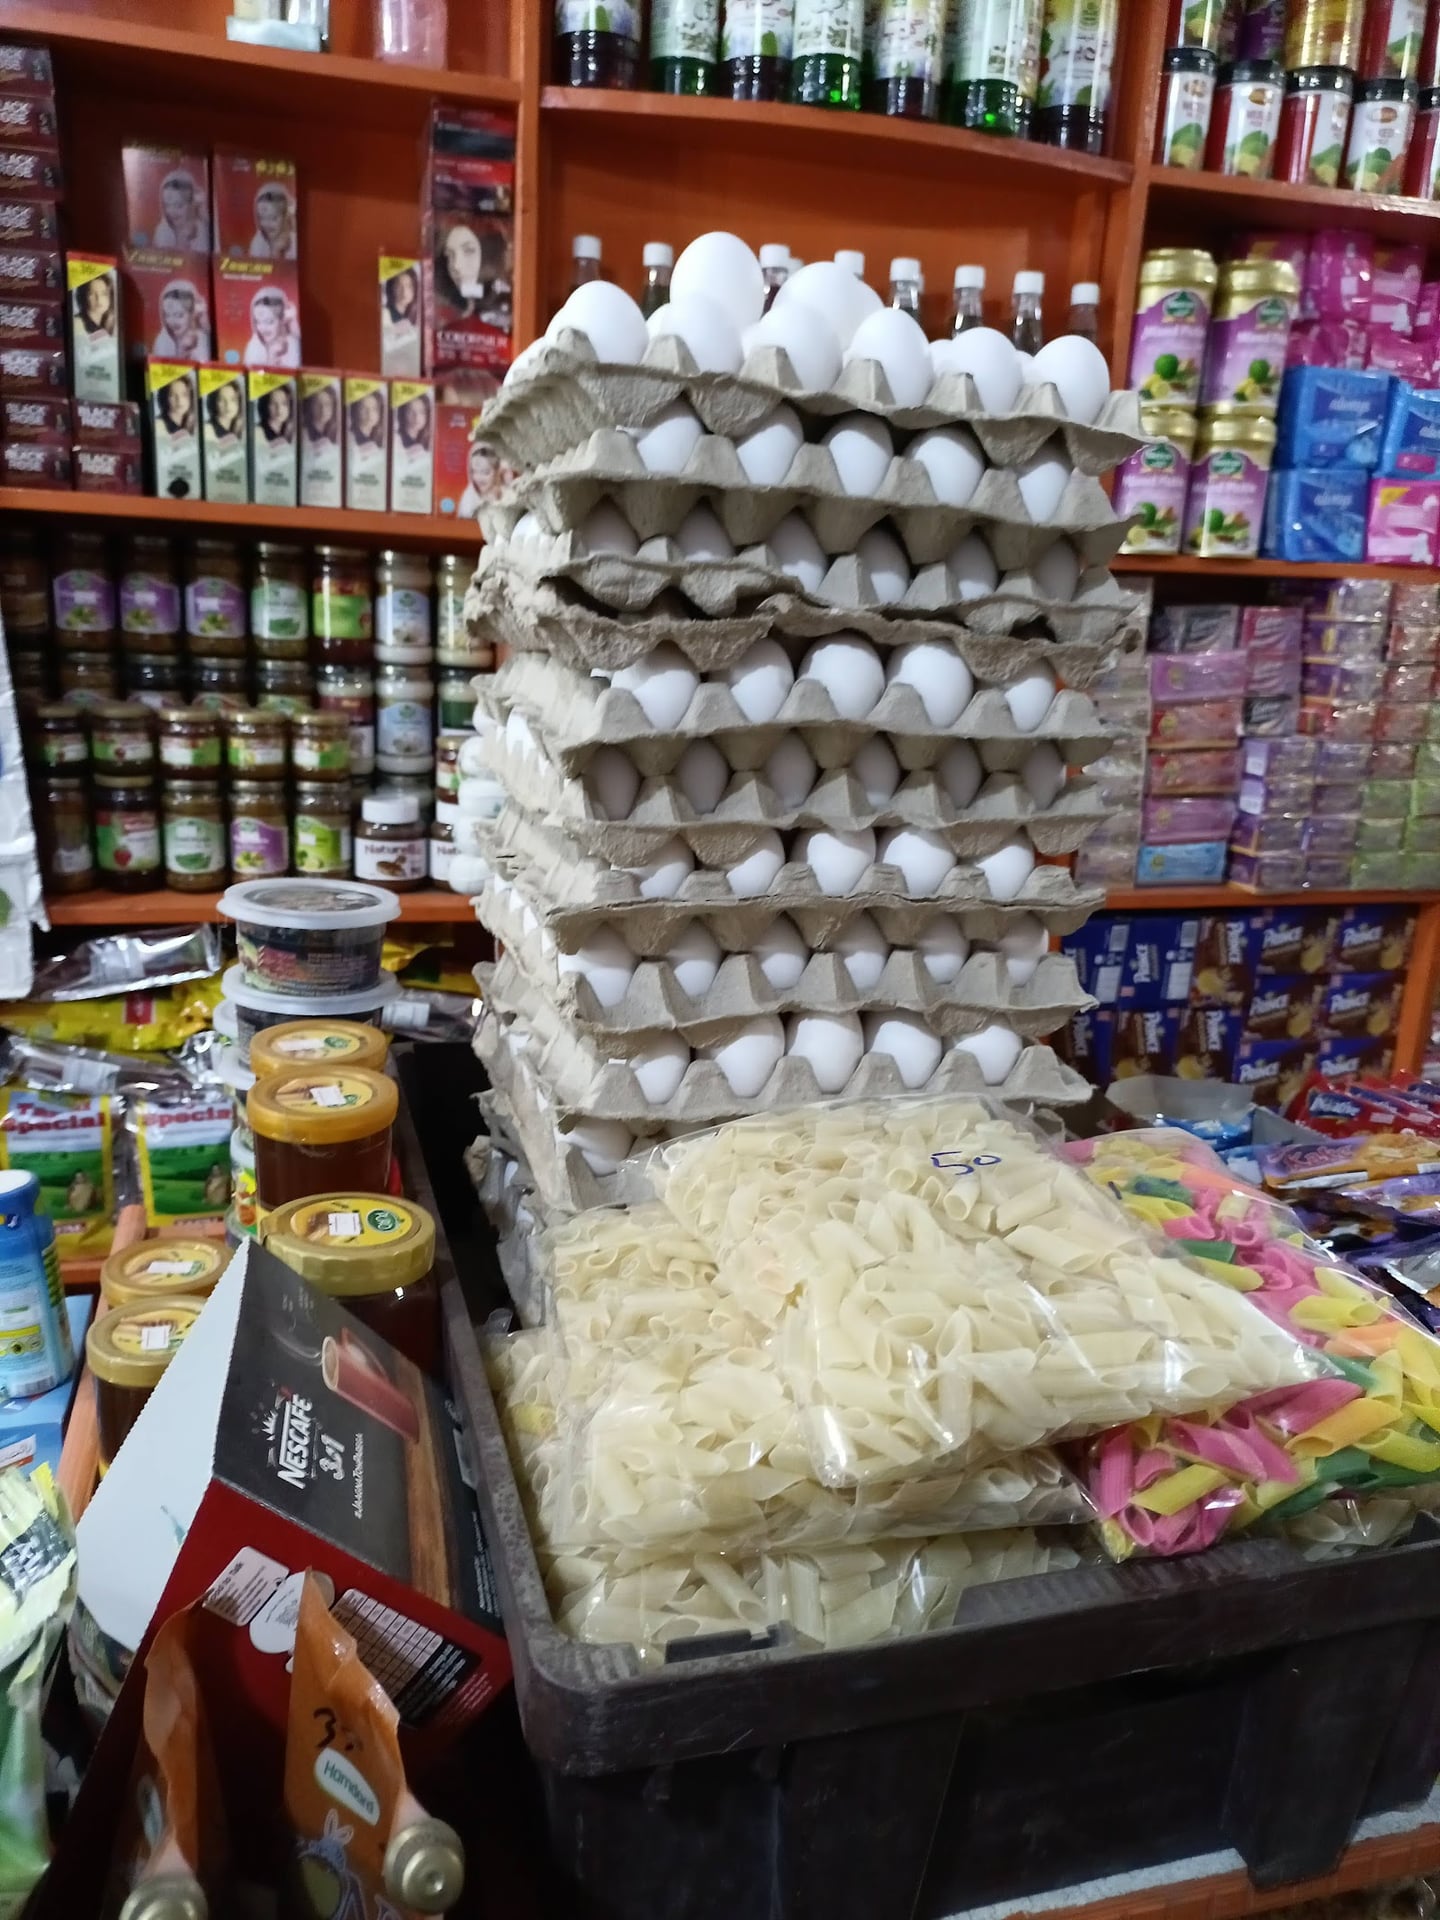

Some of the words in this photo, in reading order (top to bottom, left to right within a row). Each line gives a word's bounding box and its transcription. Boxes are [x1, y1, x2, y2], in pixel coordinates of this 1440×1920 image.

[77, 404, 119, 418] BLACK
[81, 416, 116, 429] ROSE
[77, 452, 120, 465] BLACK
[81, 462, 116, 475] ROSE
[143, 1107, 233, 1128] Specia
[929, 1150, 1003, 1176] 50
